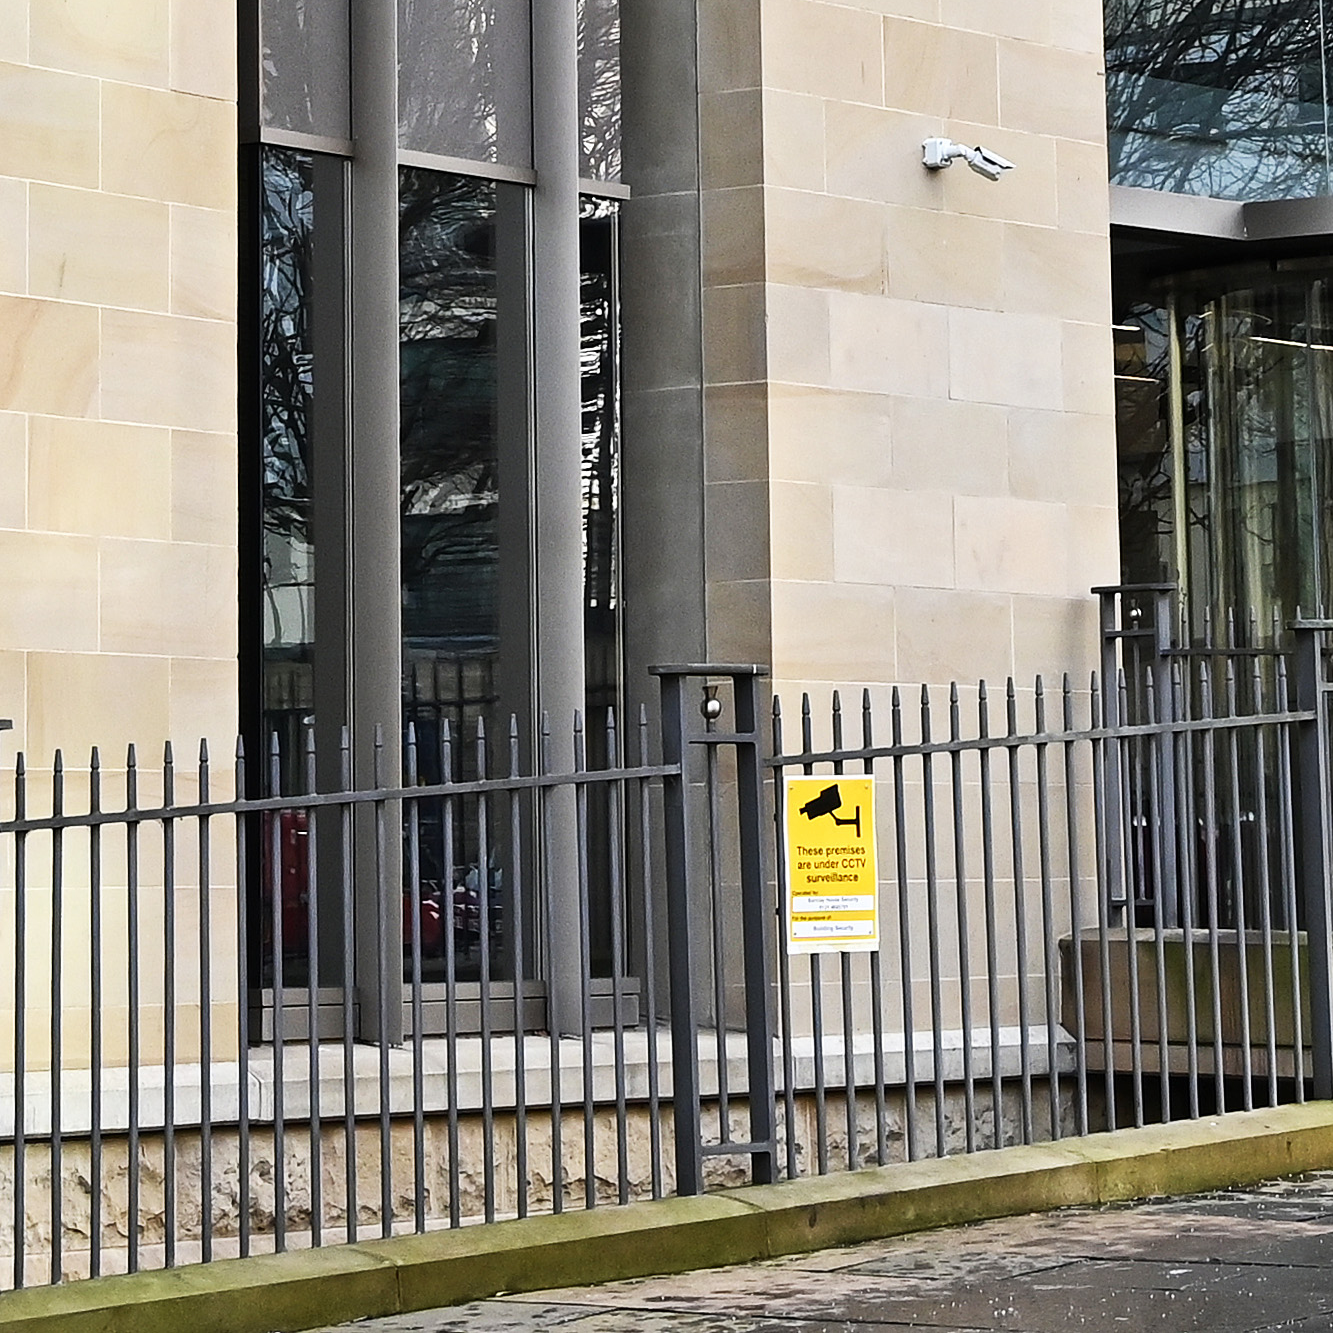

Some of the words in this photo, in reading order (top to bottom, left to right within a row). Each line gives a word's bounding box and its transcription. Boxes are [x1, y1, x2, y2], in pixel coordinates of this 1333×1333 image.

[797, 846, 823, 856] These
[826, 846, 865, 857] premises
[797, 861, 811, 869] are
[814, 860, 839, 869] under
[841, 858, 865, 868] CCTV
[806, 872, 858, 883] surveillance
